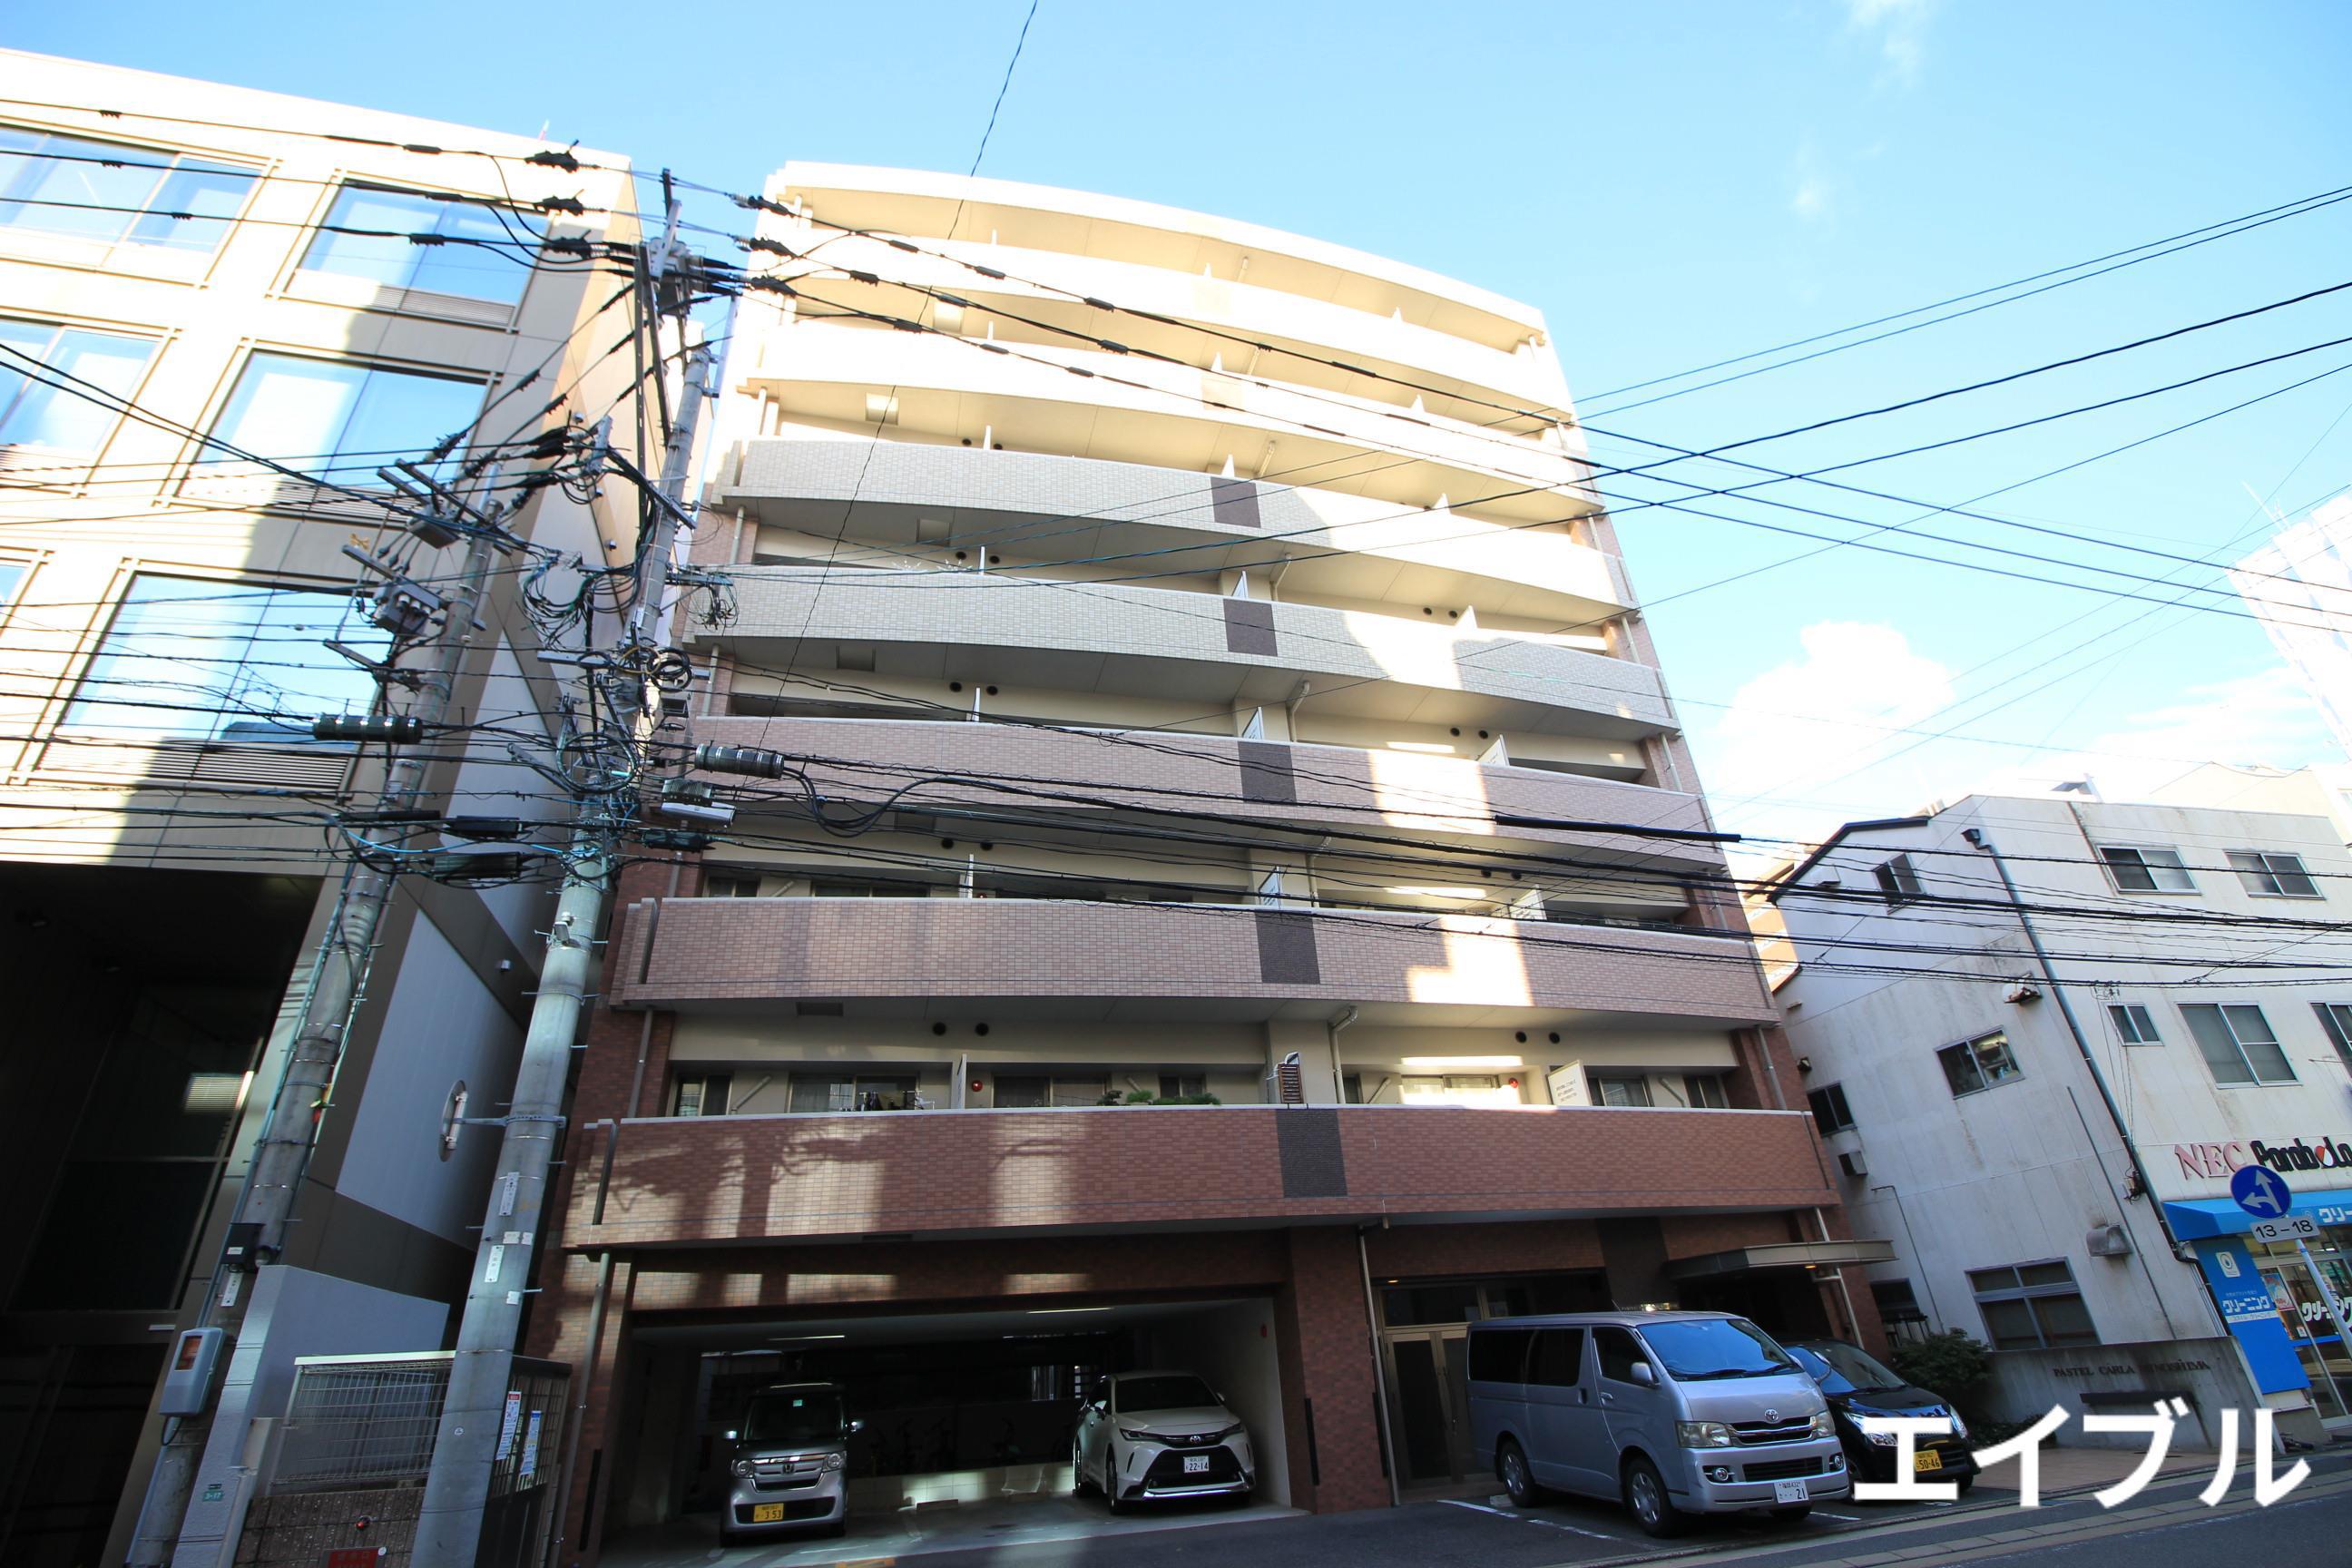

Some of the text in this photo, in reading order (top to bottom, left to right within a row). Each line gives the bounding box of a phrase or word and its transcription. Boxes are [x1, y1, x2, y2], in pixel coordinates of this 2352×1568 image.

[2175, 1142, 2243, 1180] NEC
[2222, 1295, 2270, 1314] クリーニング
[2053, 1367, 2093, 1377] PASTEL
[2098, 1364, 2135, 1376] CARLA
